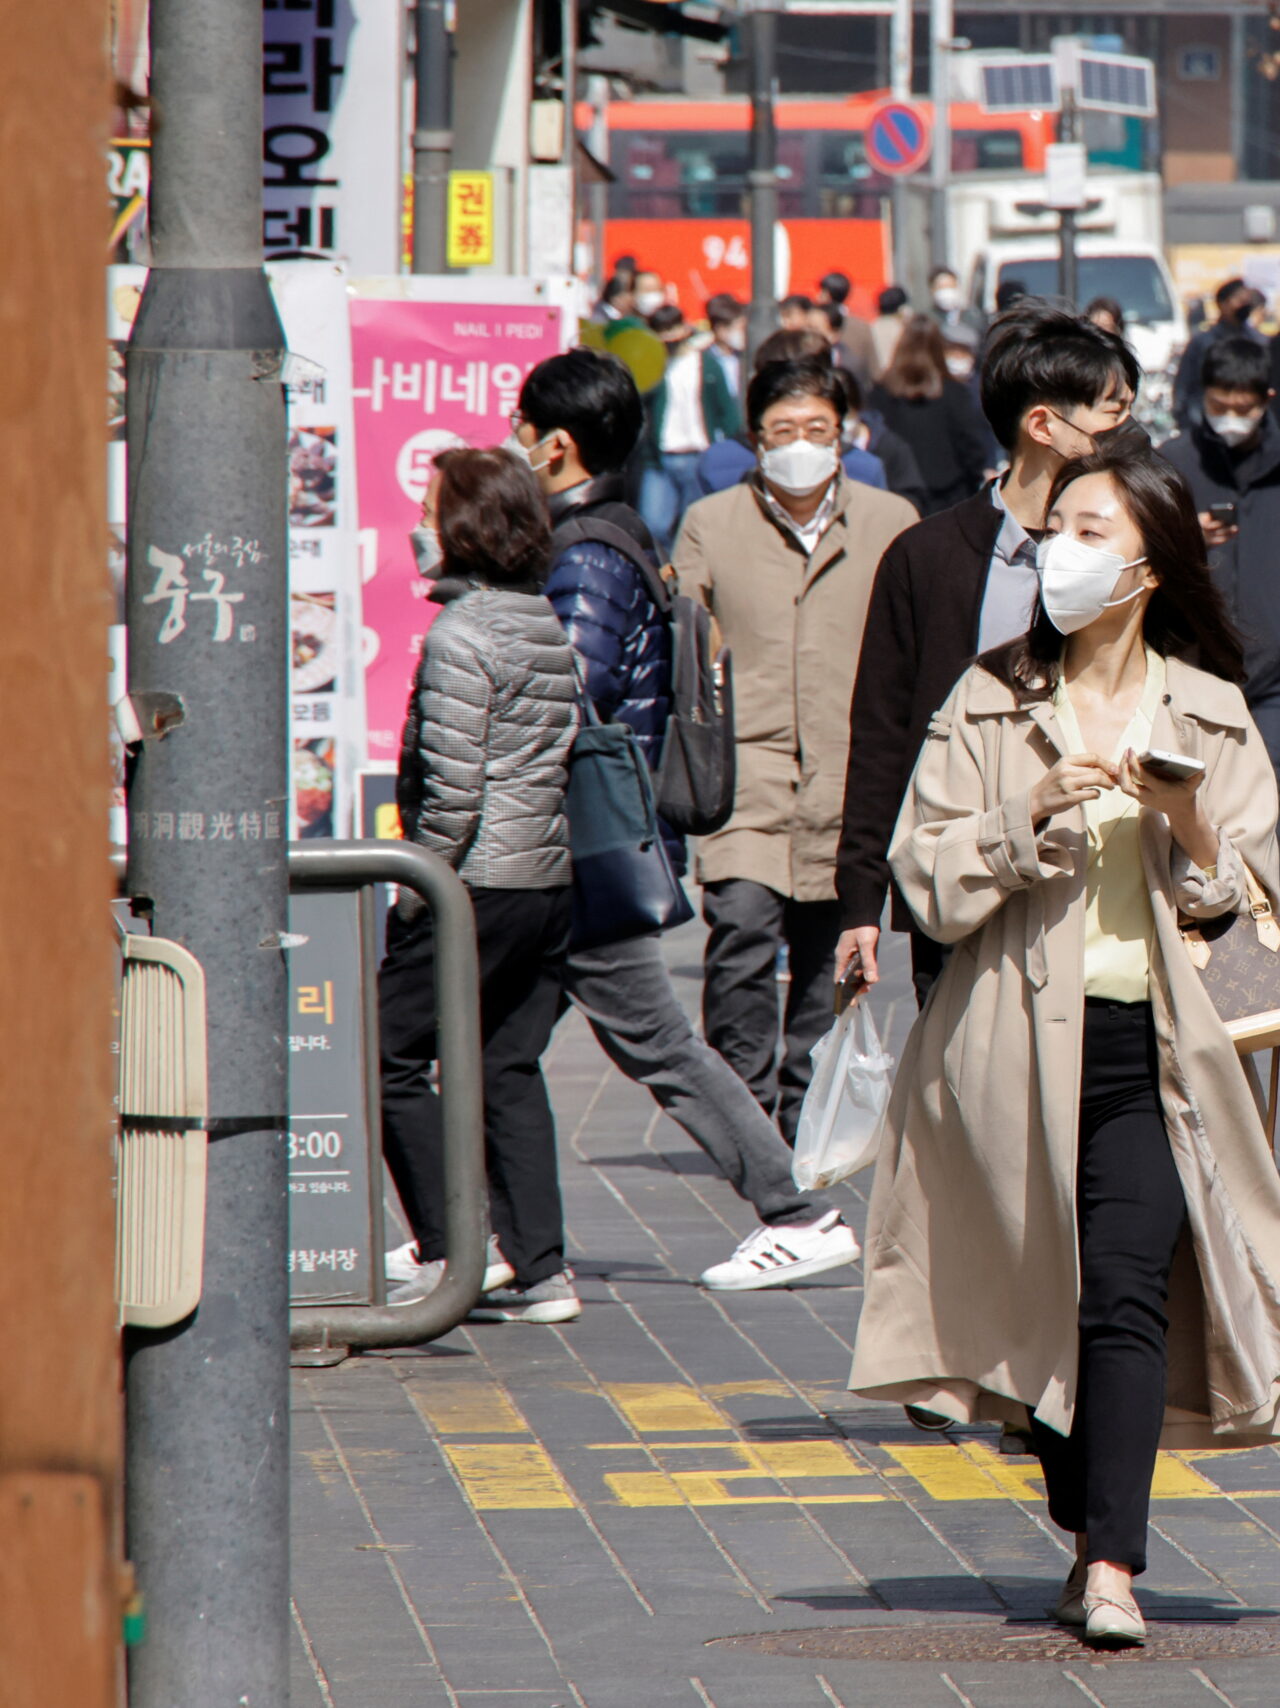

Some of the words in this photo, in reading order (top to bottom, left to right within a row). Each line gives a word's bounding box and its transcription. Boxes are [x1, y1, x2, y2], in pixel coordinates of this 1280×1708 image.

[454, 321, 490, 338] NAIL
[506, 323, 543, 339] PEDI
[142, 544, 245, 645] 중구
